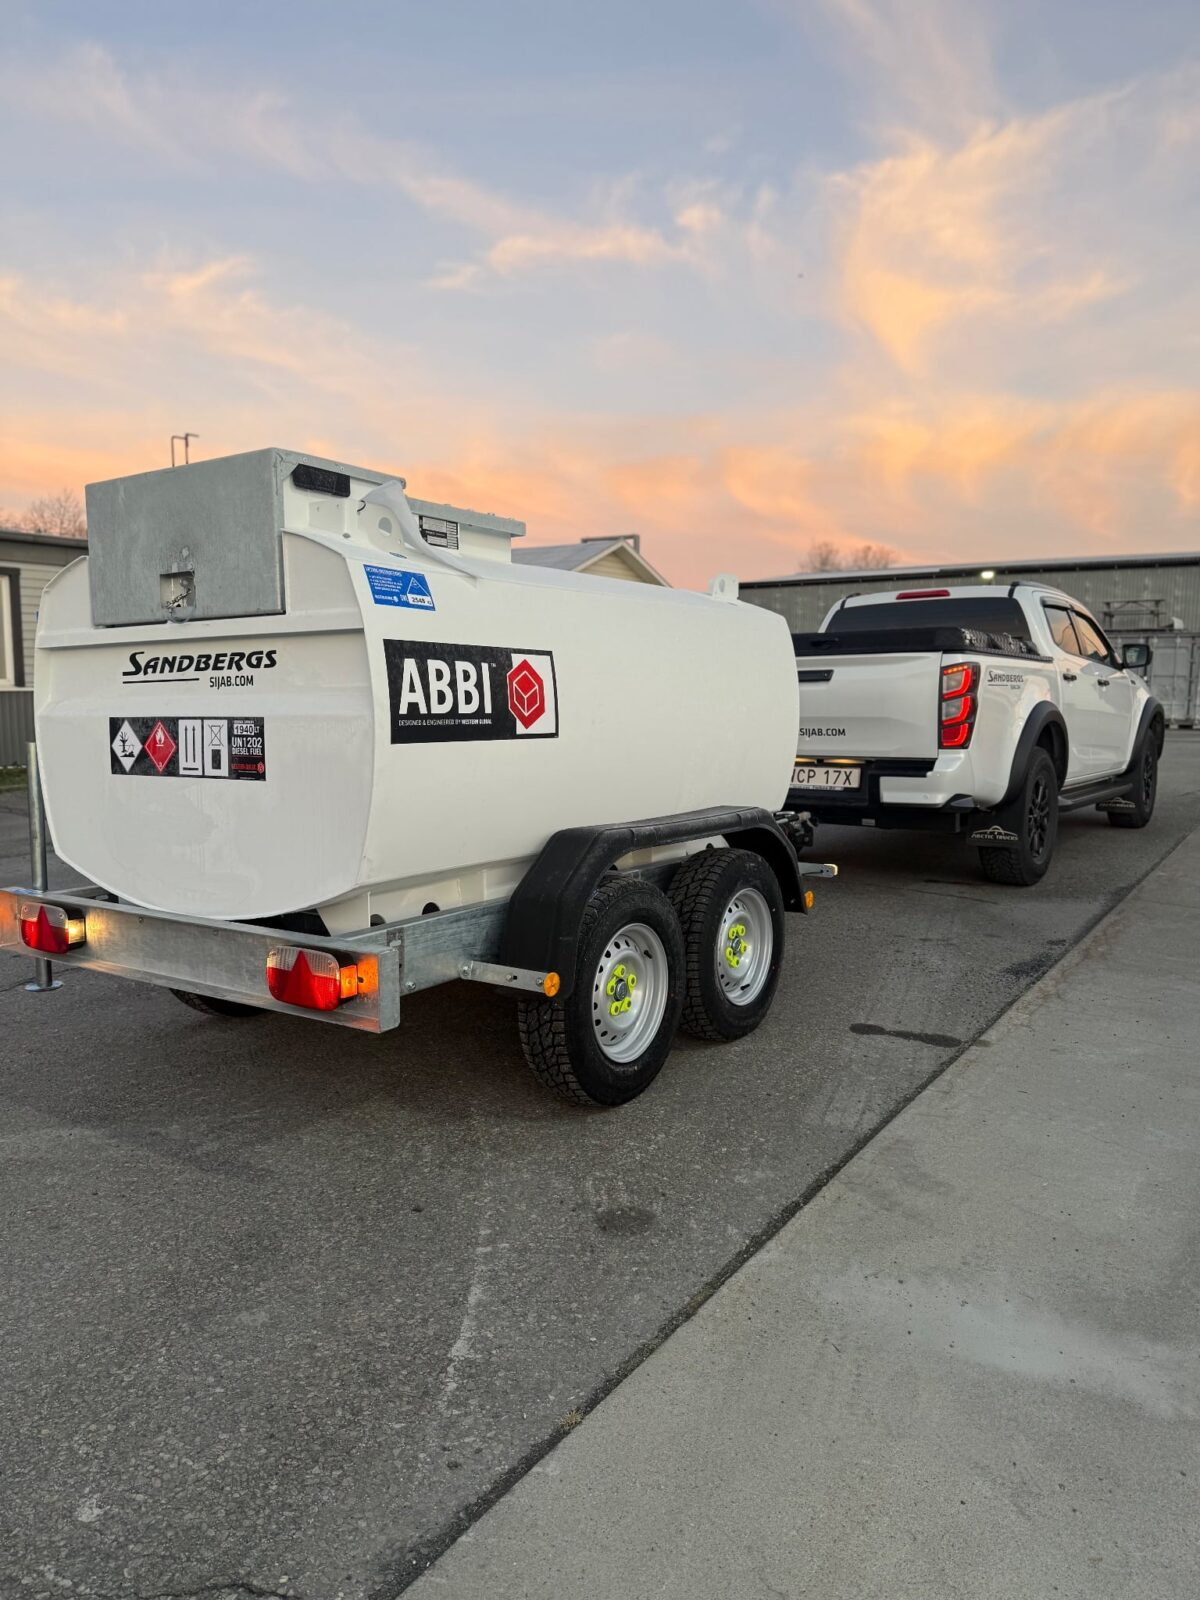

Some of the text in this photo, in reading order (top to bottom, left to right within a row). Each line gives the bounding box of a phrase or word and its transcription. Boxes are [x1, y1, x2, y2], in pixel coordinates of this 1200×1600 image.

[122, 650, 277, 676] SANDBERGS
[209, 675, 254, 690] SIJAB.COM
[399, 658, 492, 714] ABBI
[234, 725, 254, 734] 1940
[799, 728, 846, 738] SIJAB.COM
[231, 737, 263, 748] UN1202
[231, 747, 249, 755] DIESEL
[823, 769, 853, 786] 17X
